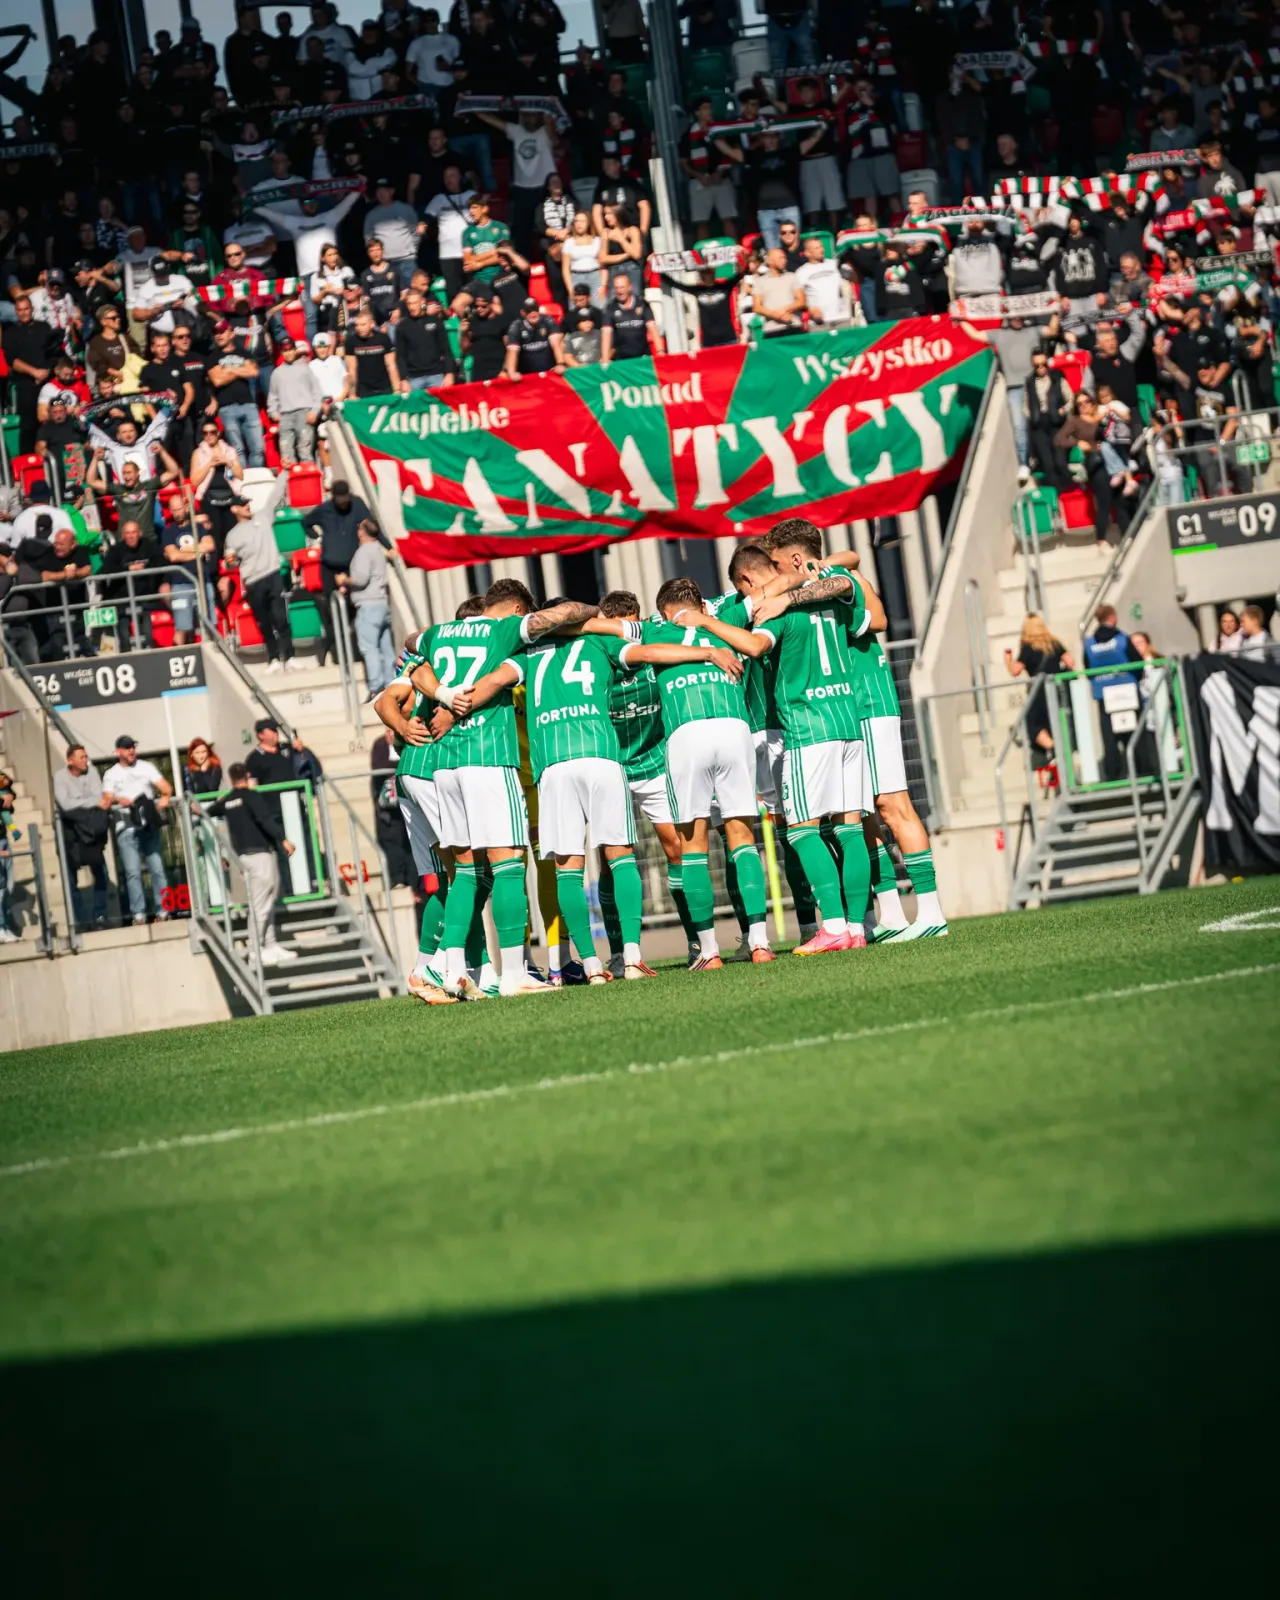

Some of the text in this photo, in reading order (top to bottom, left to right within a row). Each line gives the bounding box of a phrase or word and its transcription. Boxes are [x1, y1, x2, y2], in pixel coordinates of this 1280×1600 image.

[600, 372, 704, 412] Ponad
[793, 336, 953, 385] Wszystko
[368, 382, 957, 539] FANATYCY
[1176, 512, 1203, 537] C1
[1238, 501, 1277, 537] 09
[95, 663, 138, 697] 08
[168, 655, 197, 678] B7
[433, 645, 487, 687] 27
[526, 639, 595, 708] 74
[805, 682, 854, 701] FORTU
